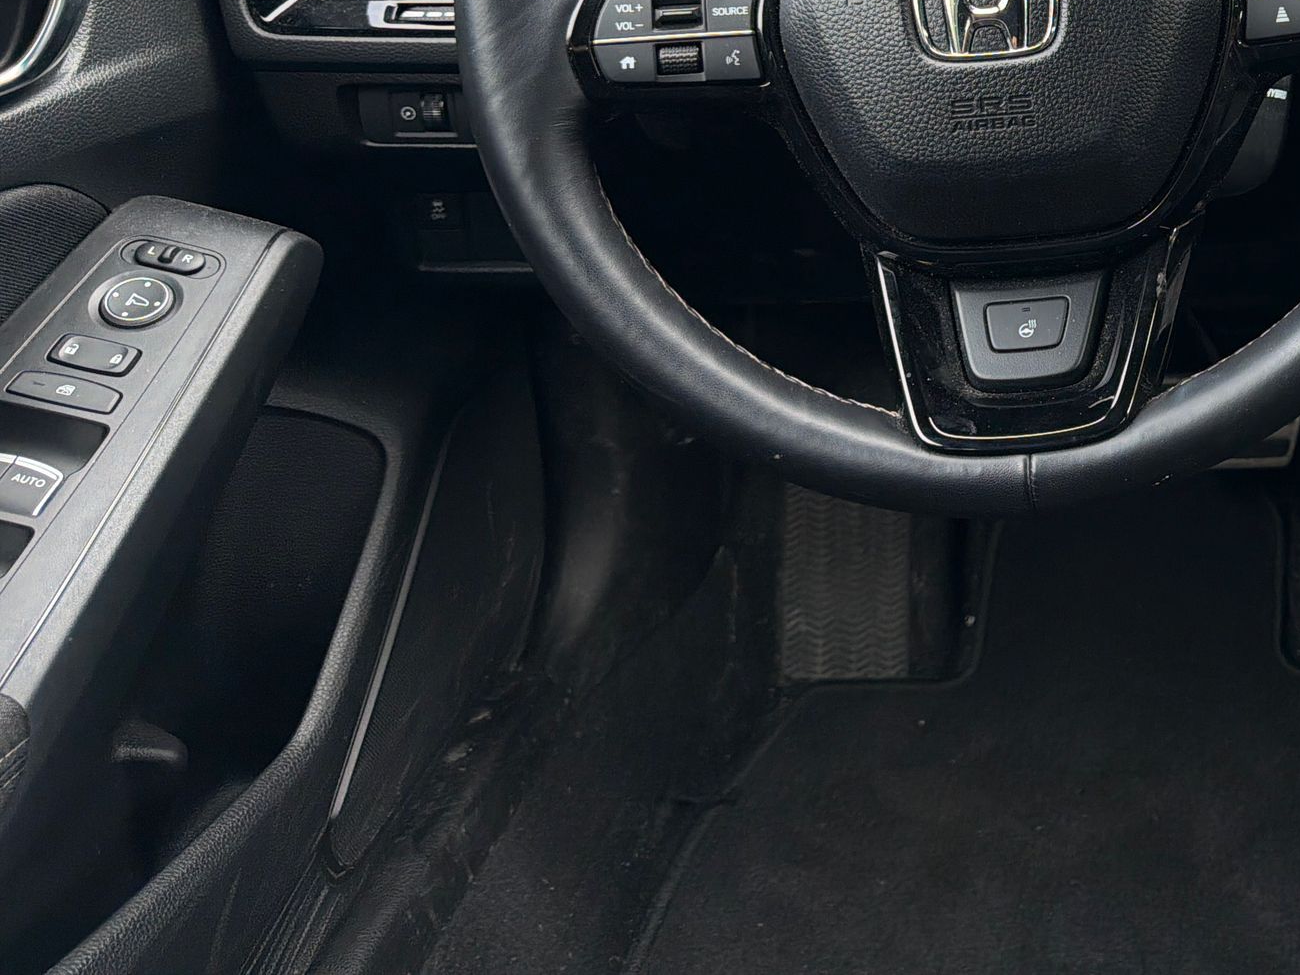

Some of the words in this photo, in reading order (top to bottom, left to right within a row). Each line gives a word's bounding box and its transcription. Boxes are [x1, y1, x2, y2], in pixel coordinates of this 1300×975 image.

[712, 6, 749, 16] SOURCE
[950, 116, 1037, 133] AIRBAG
[148, 245, 156, 256] L
[181, 253, 194, 264] R
[10, 472, 47, 489] AUTO
